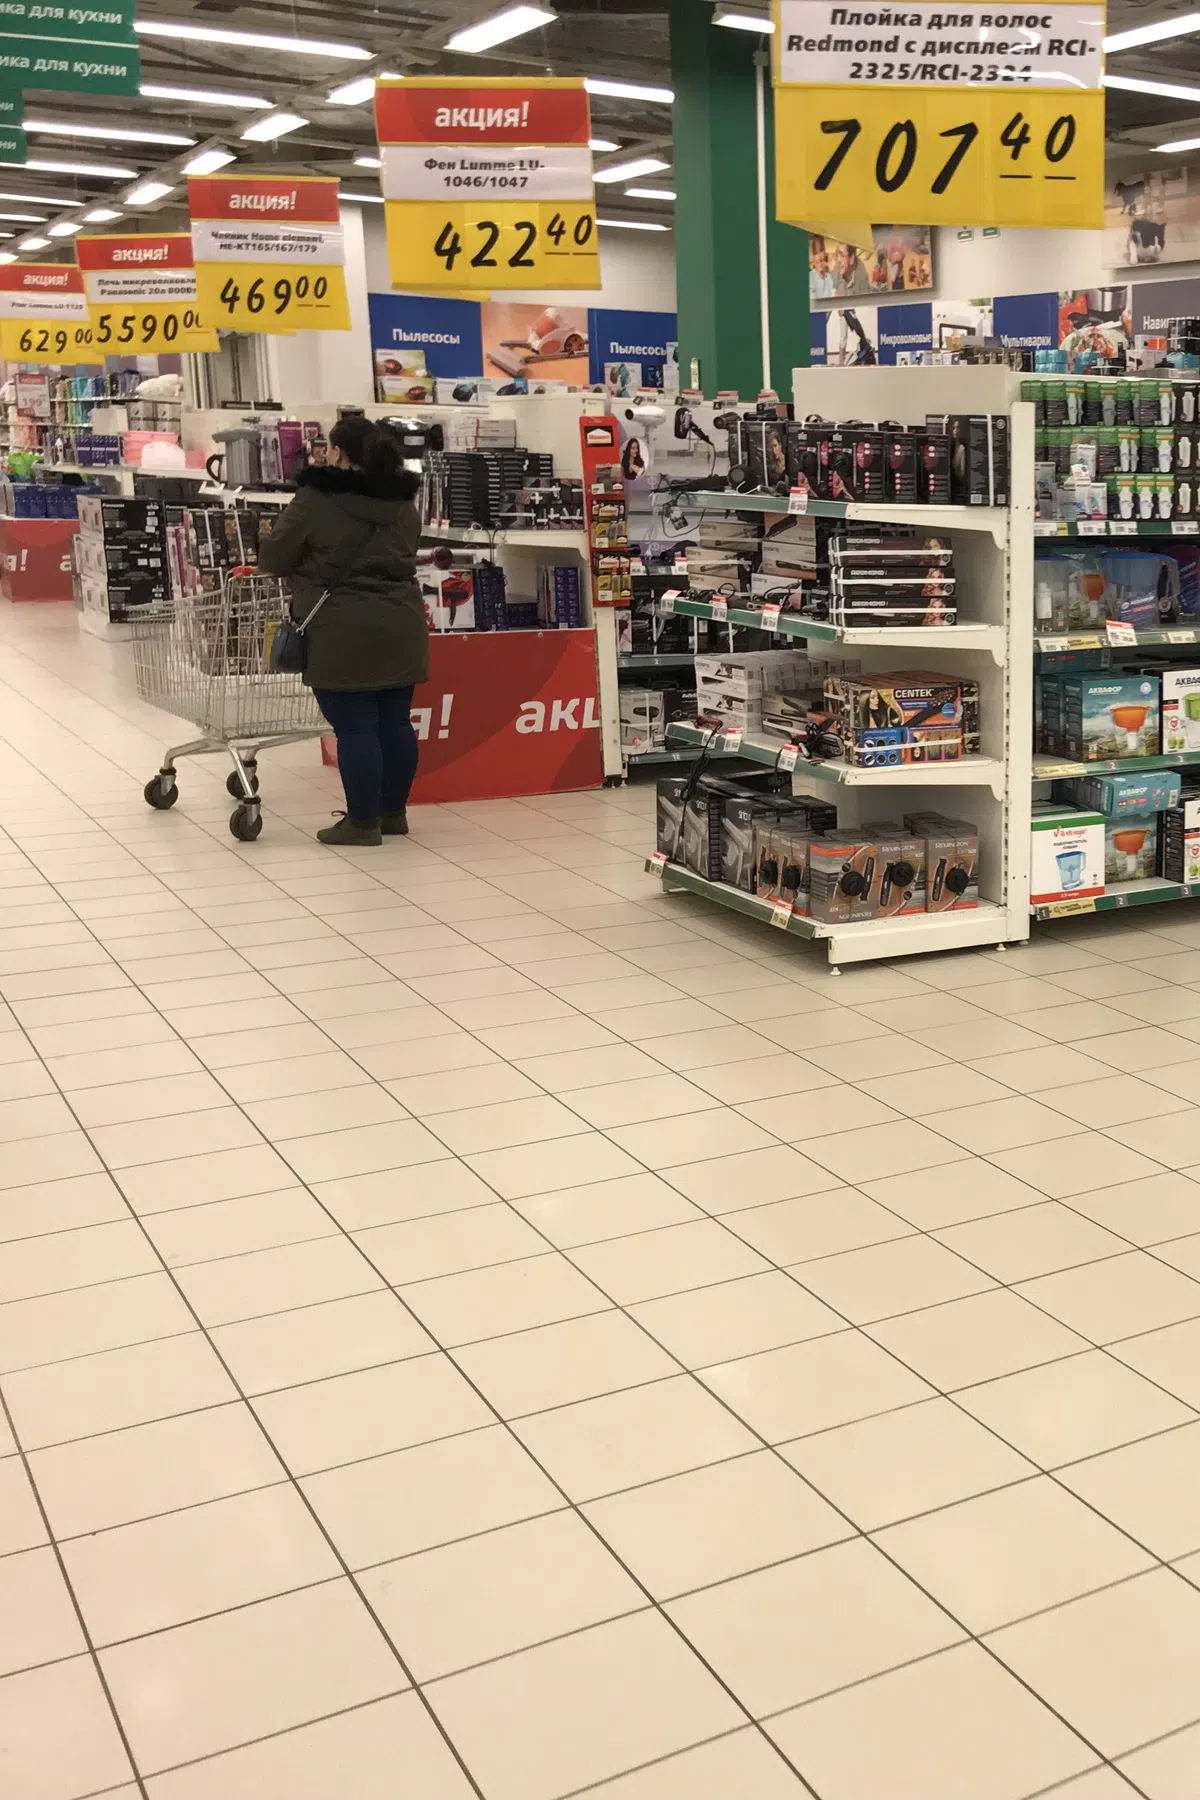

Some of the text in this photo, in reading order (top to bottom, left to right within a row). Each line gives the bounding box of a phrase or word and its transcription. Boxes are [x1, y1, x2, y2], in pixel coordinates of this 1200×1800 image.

[28, 4, 64, 19] для
[68, 8, 123, 24] кухни
[830, 9, 1053, 30] Плойка для волос
[787, 34, 1097, 58] Redmond с дисплеем RCI-
[33, 58, 69, 72] для
[73, 61, 127, 76] кухни
[850, 62, 1033, 82] 2325/RCI-2324
[435, 101, 529, 129] акция!
[814, 112, 1076, 194] 707 40
[424, 158, 456, 171] Фен
[460, 159, 515, 171] Lumme
[443, 176, 528, 188] 1046/1047
[229, 191, 297, 211] акция!
[434, 213, 592, 270] 422 40
[112, 244, 169, 261] акция!
[23, 272, 69, 287] акция!
[220, 276, 327, 314] 469 00
[97, 314, 179, 344] 5590
[393, 329, 460, 345] Пылесосы
[20, 328, 93, 354] 629 00
[880, 333, 932, 346] Микроволновые
[895, 689, 932, 698] CENTEK
